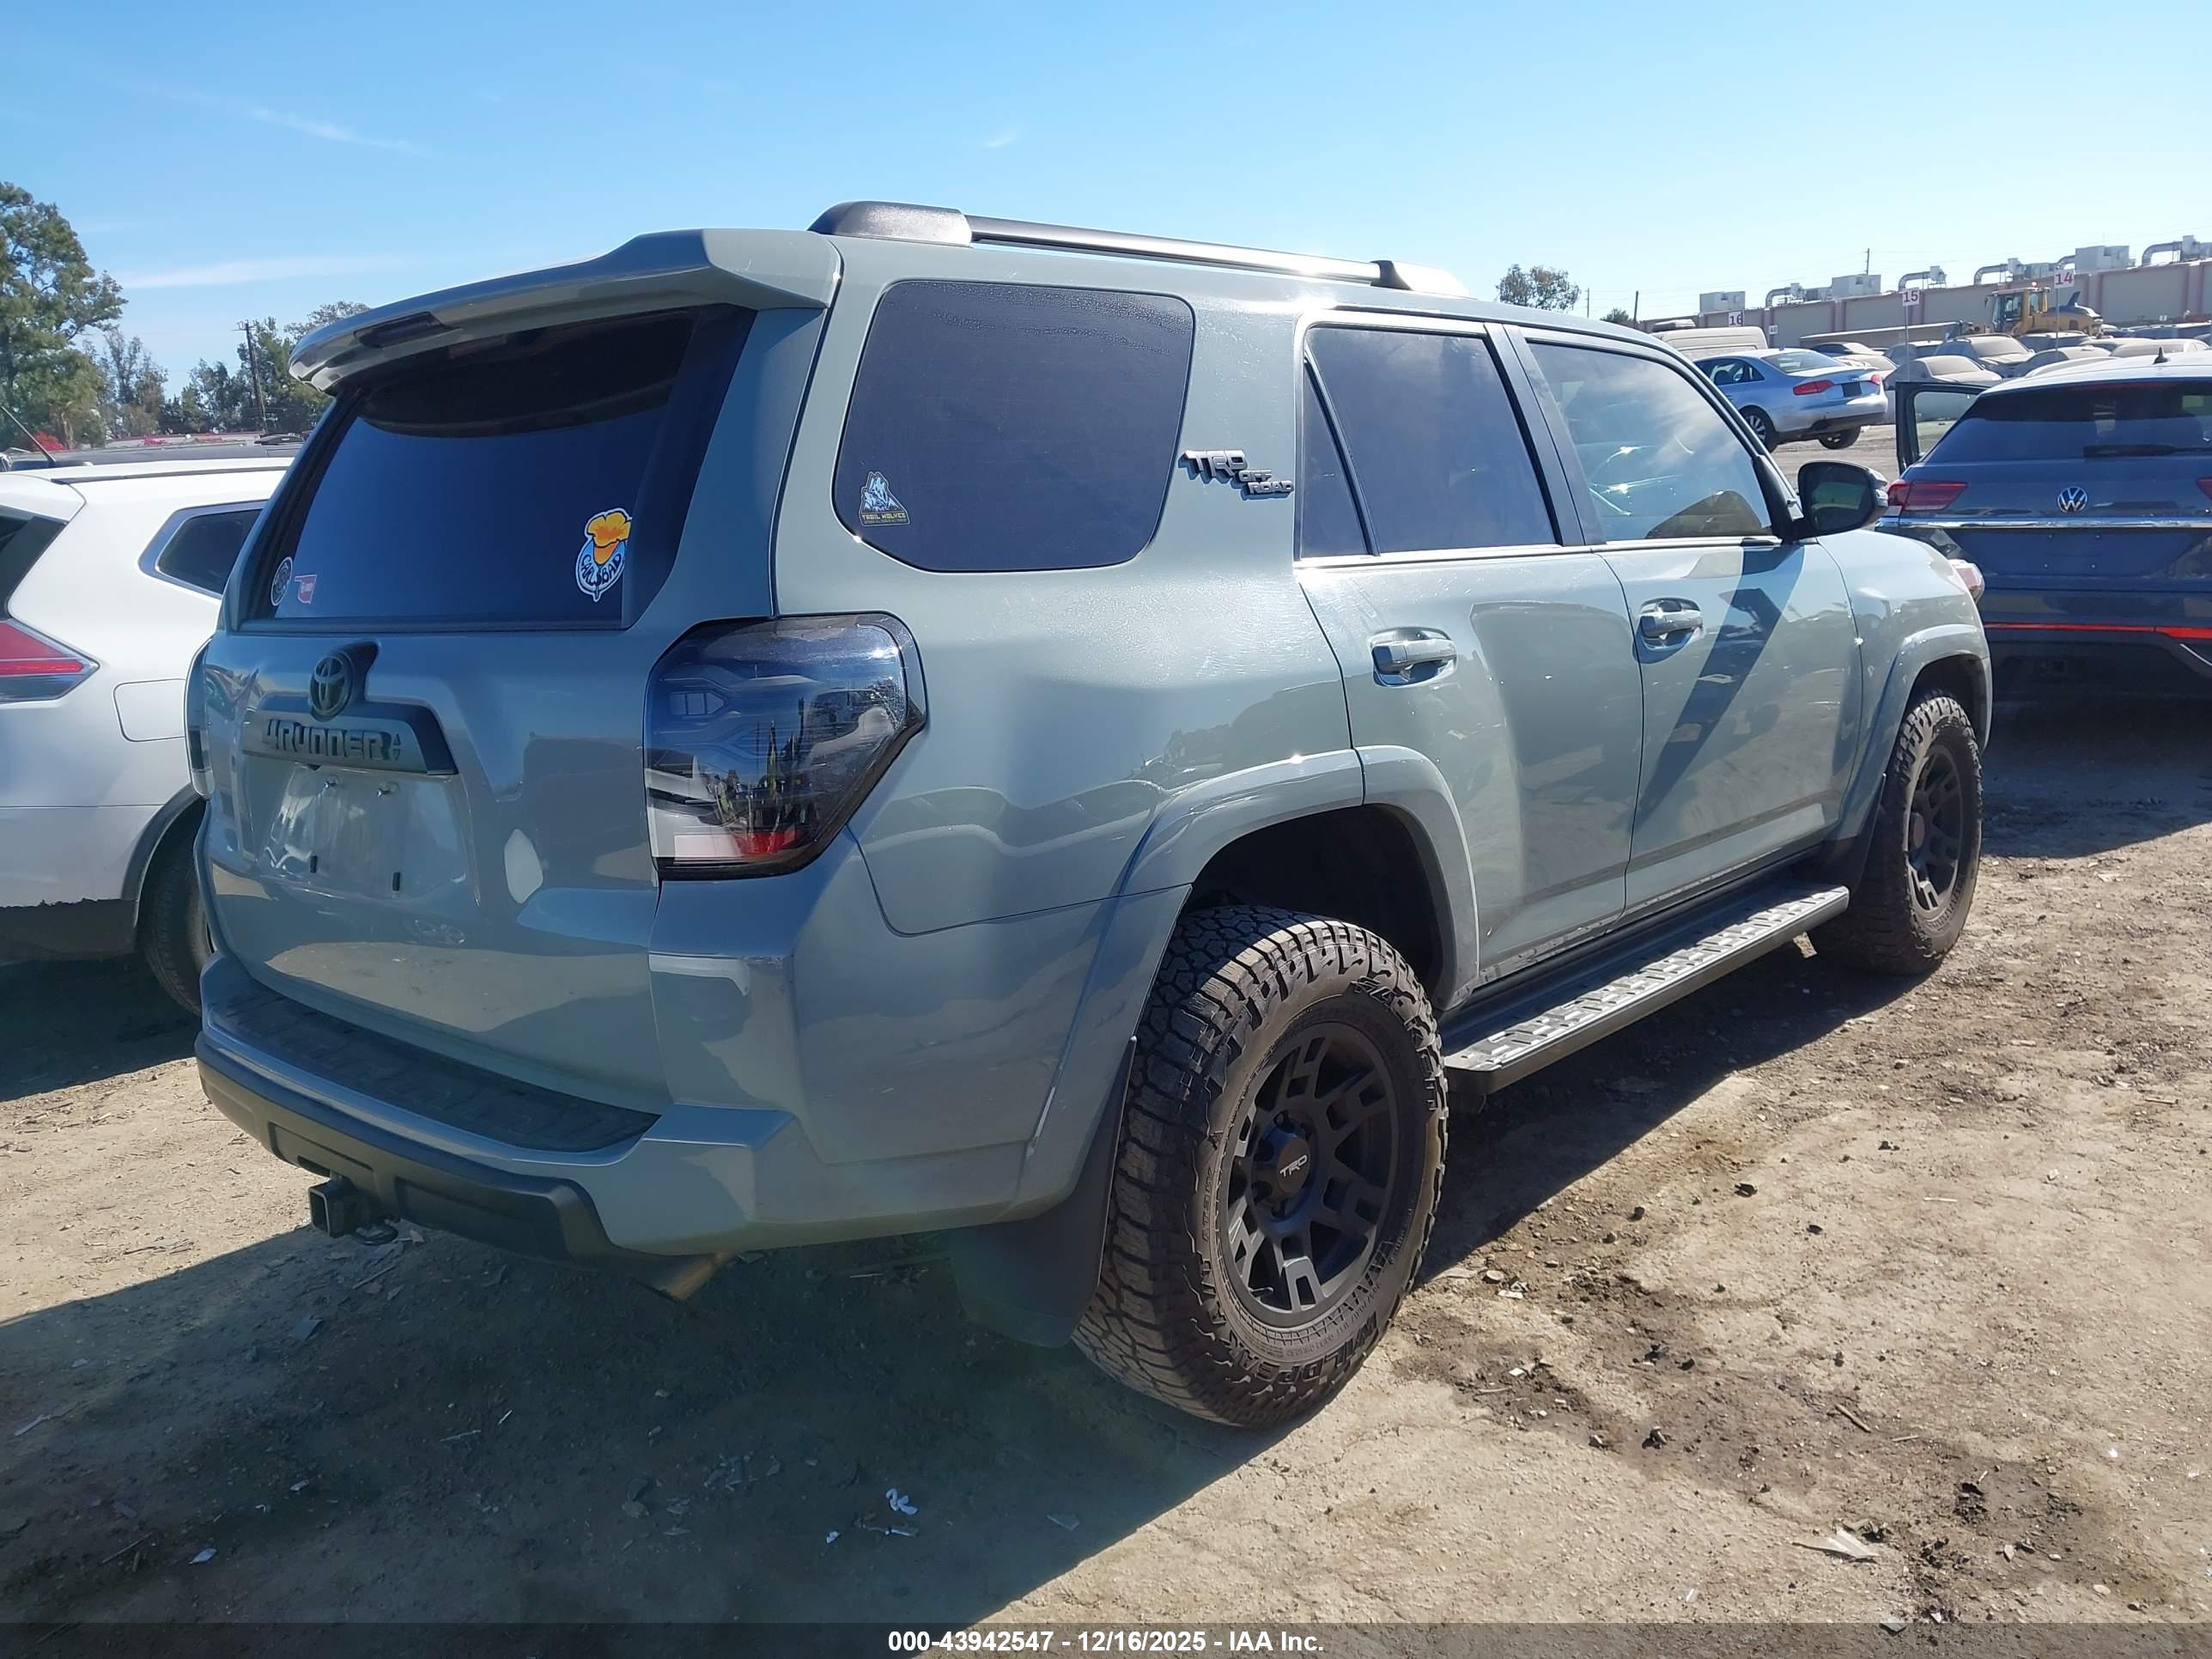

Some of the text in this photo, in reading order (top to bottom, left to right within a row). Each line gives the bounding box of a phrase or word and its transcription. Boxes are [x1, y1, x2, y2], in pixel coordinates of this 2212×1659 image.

[2055, 271, 2074, 285] 14
[1903, 289, 1918, 303] 15
[1729, 314, 1744, 325] 16
[1183, 449, 1249, 477] TRD
[1238, 469, 1273, 482] OFF
[1248, 480, 1294, 495] ROAD
[262, 718, 388, 761] 4RUNNER
[1279, 1154, 1308, 1178] TRD
